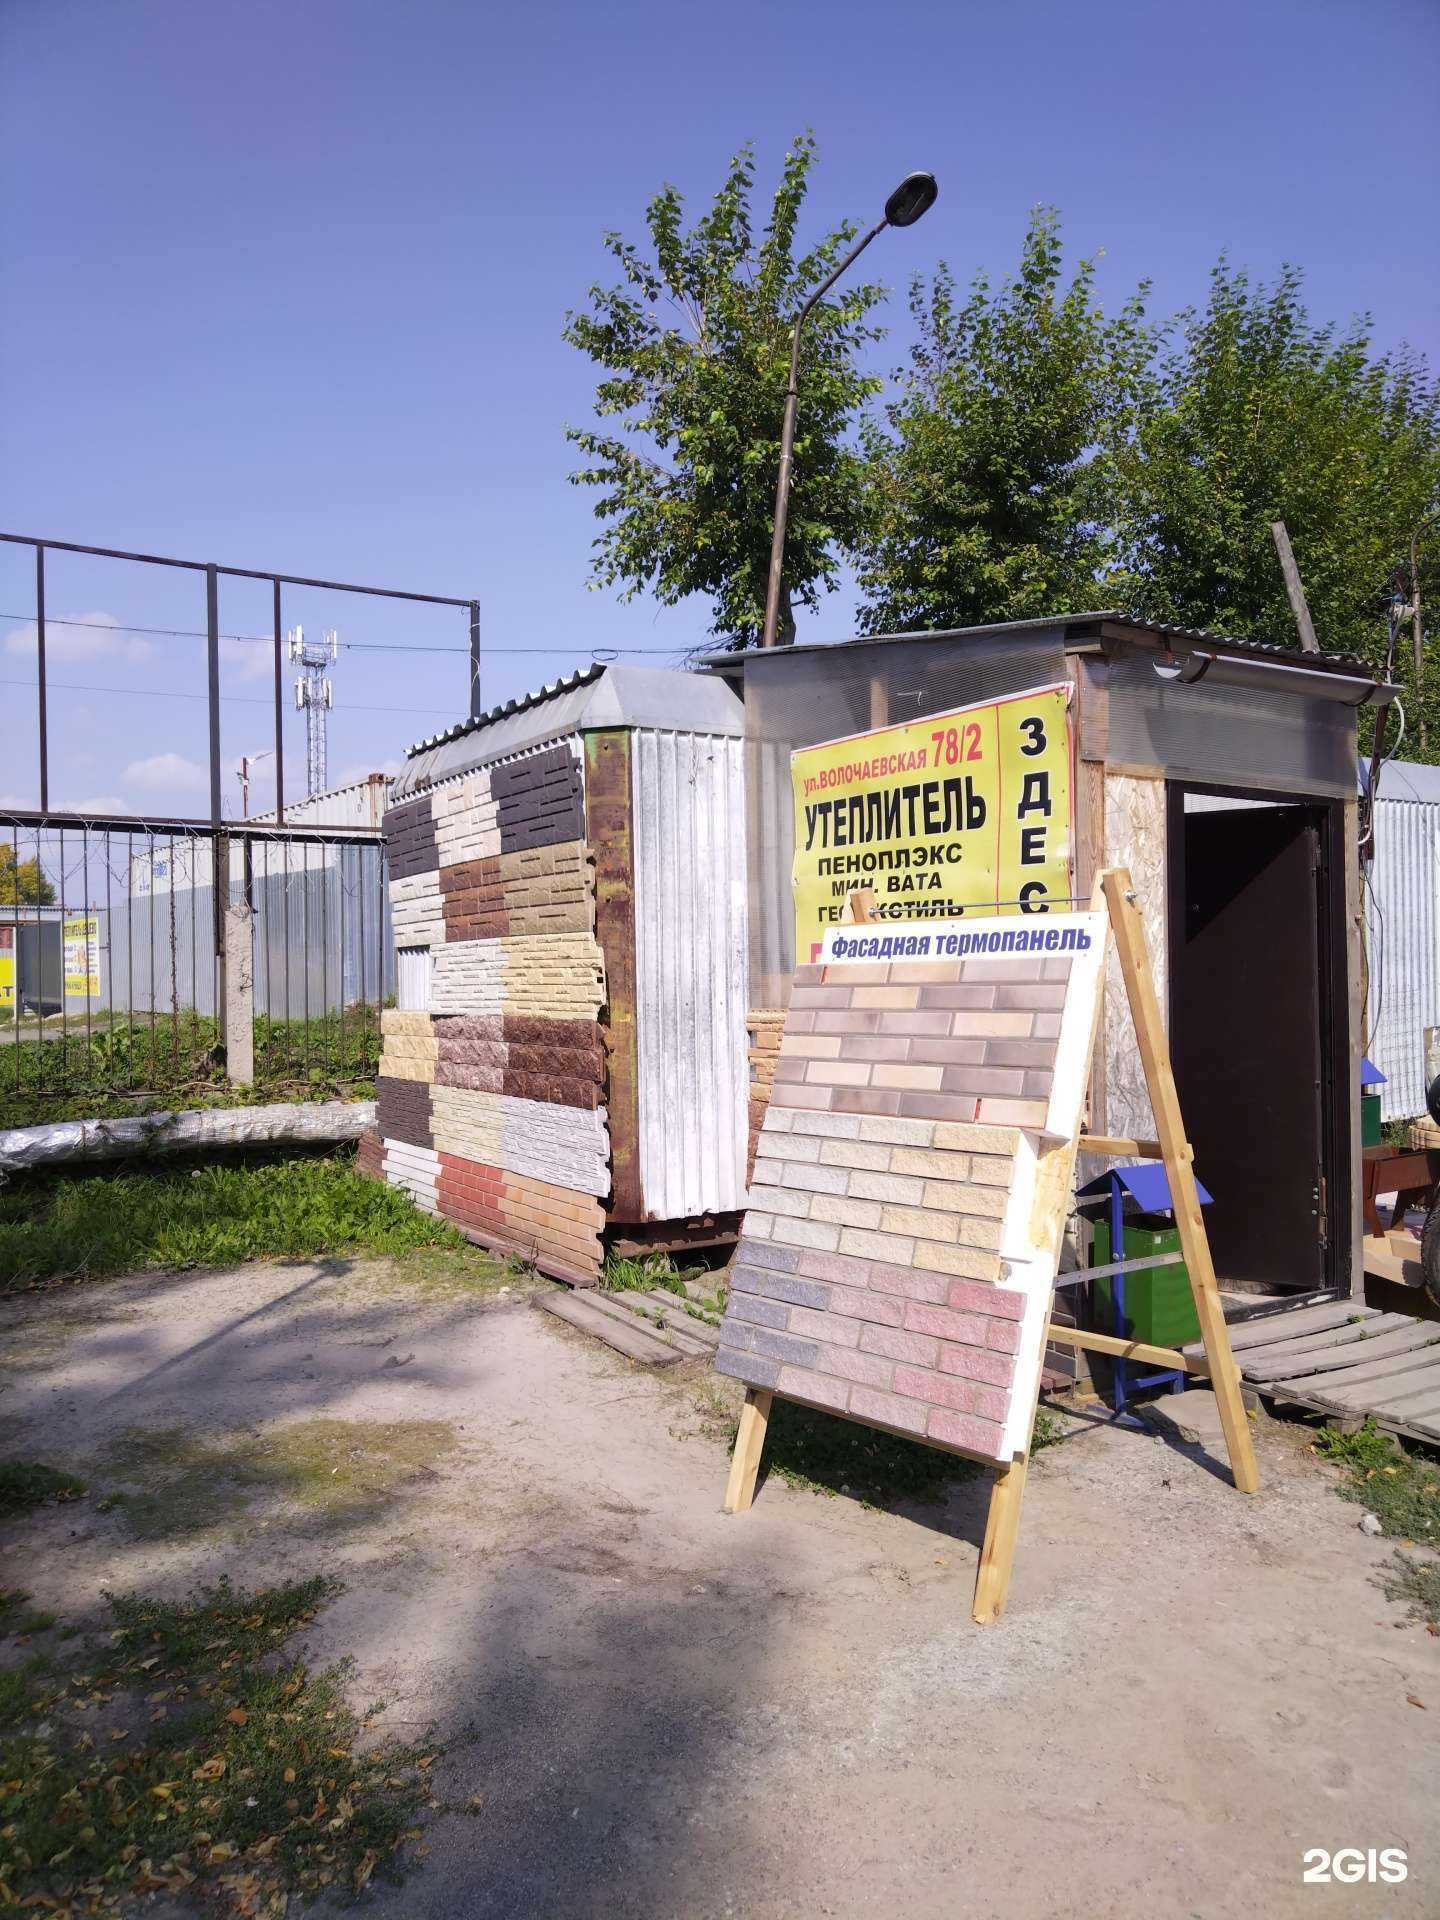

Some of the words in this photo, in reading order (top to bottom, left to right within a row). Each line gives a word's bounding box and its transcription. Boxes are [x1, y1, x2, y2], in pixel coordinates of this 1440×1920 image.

[803, 748, 927, 797] ул.ВОЛОЧАЕВСКАЯ
[931, 723, 983, 767] 78/2
[804, 775, 987, 851] УТЕПЛИТЕЛЬ
[818, 843, 963, 876] ПЕНОПЛЭКС
[887, 872, 943, 893] ВАТА
[831, 934, 931, 959] Фасадная
[936, 928, 1091, 956] термопанель
